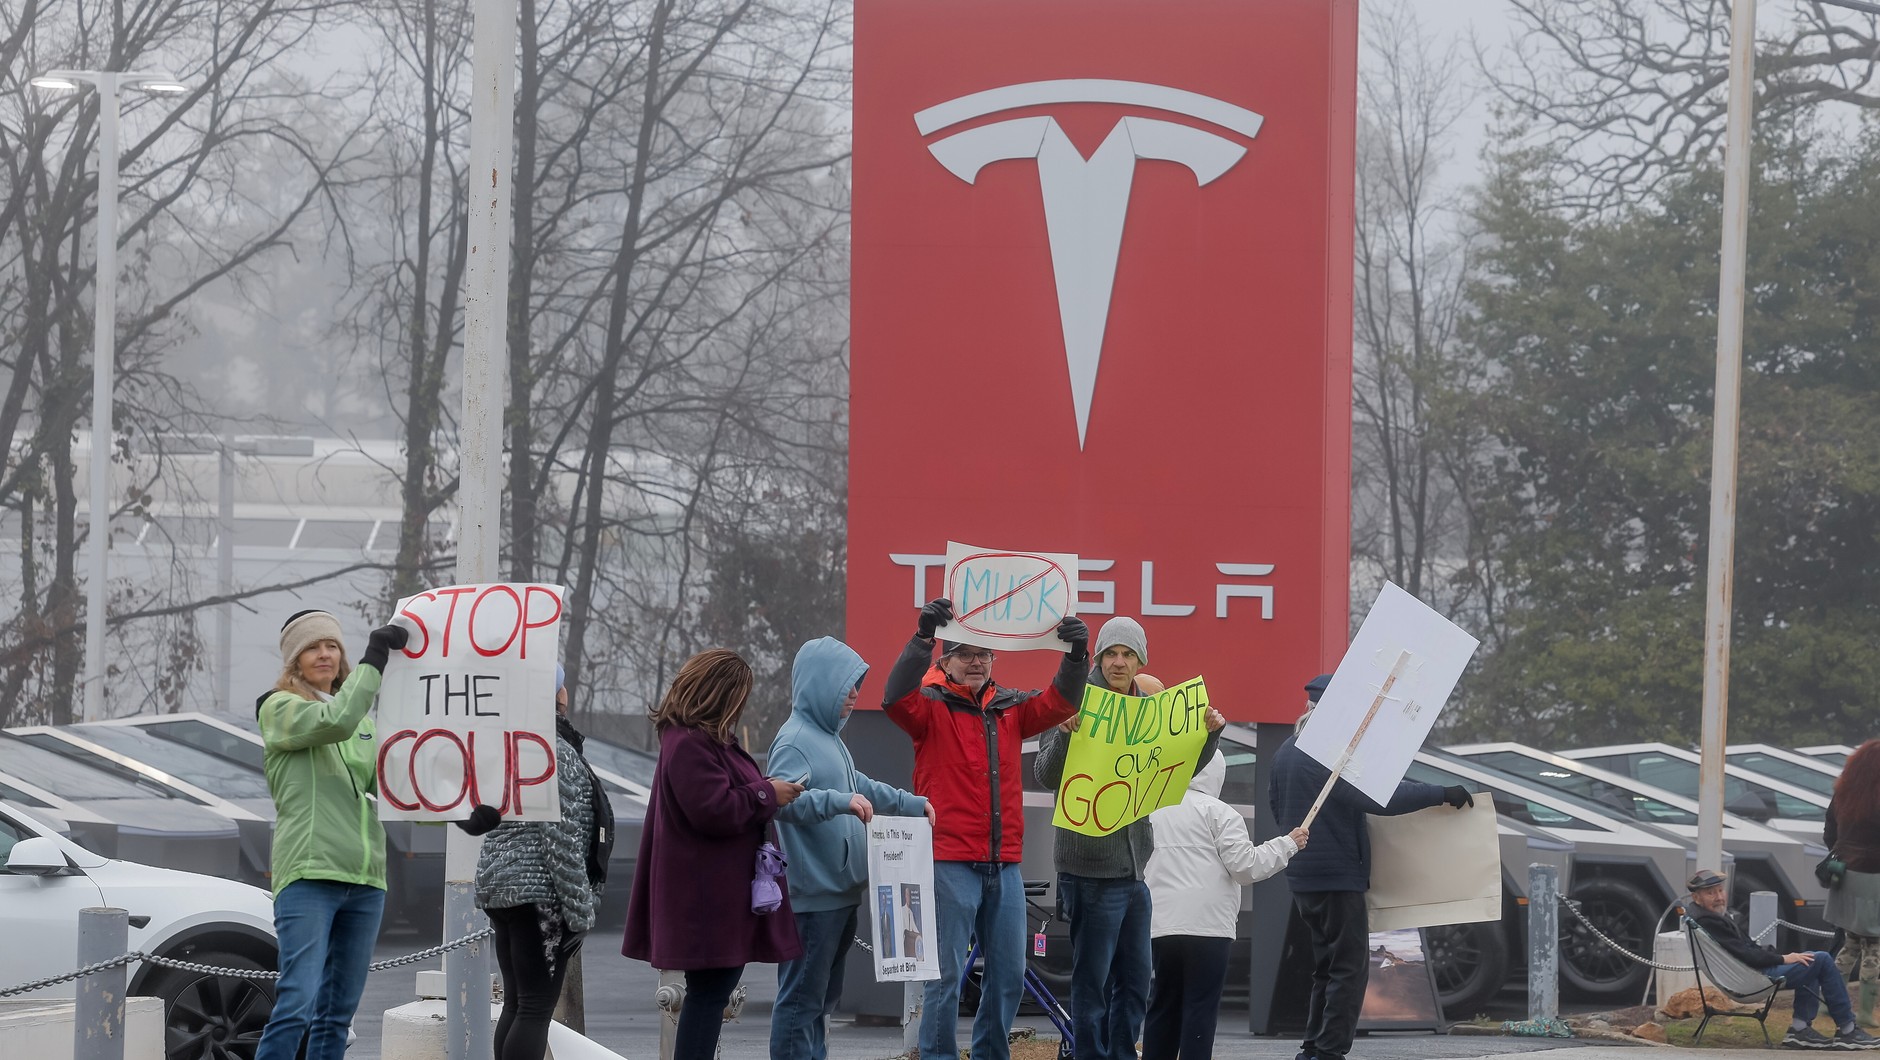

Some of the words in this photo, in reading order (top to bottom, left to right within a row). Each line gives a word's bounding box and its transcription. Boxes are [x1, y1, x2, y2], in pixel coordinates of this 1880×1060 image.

[888, 553, 1275, 620] TSLA
[962, 566, 1062, 624] MUSK
[400, 585, 562, 660] STOP
[419, 674, 500, 716] THE
[1079, 687, 1171, 746] HANDS
[1169, 681, 1206, 736] OFF
[377, 728, 556, 817] COUP
[1115, 746, 1162, 779] OUR
[891, 829, 899, 839] This
[901, 830, 913, 841] Your
[905, 962, 917, 972] Birth
